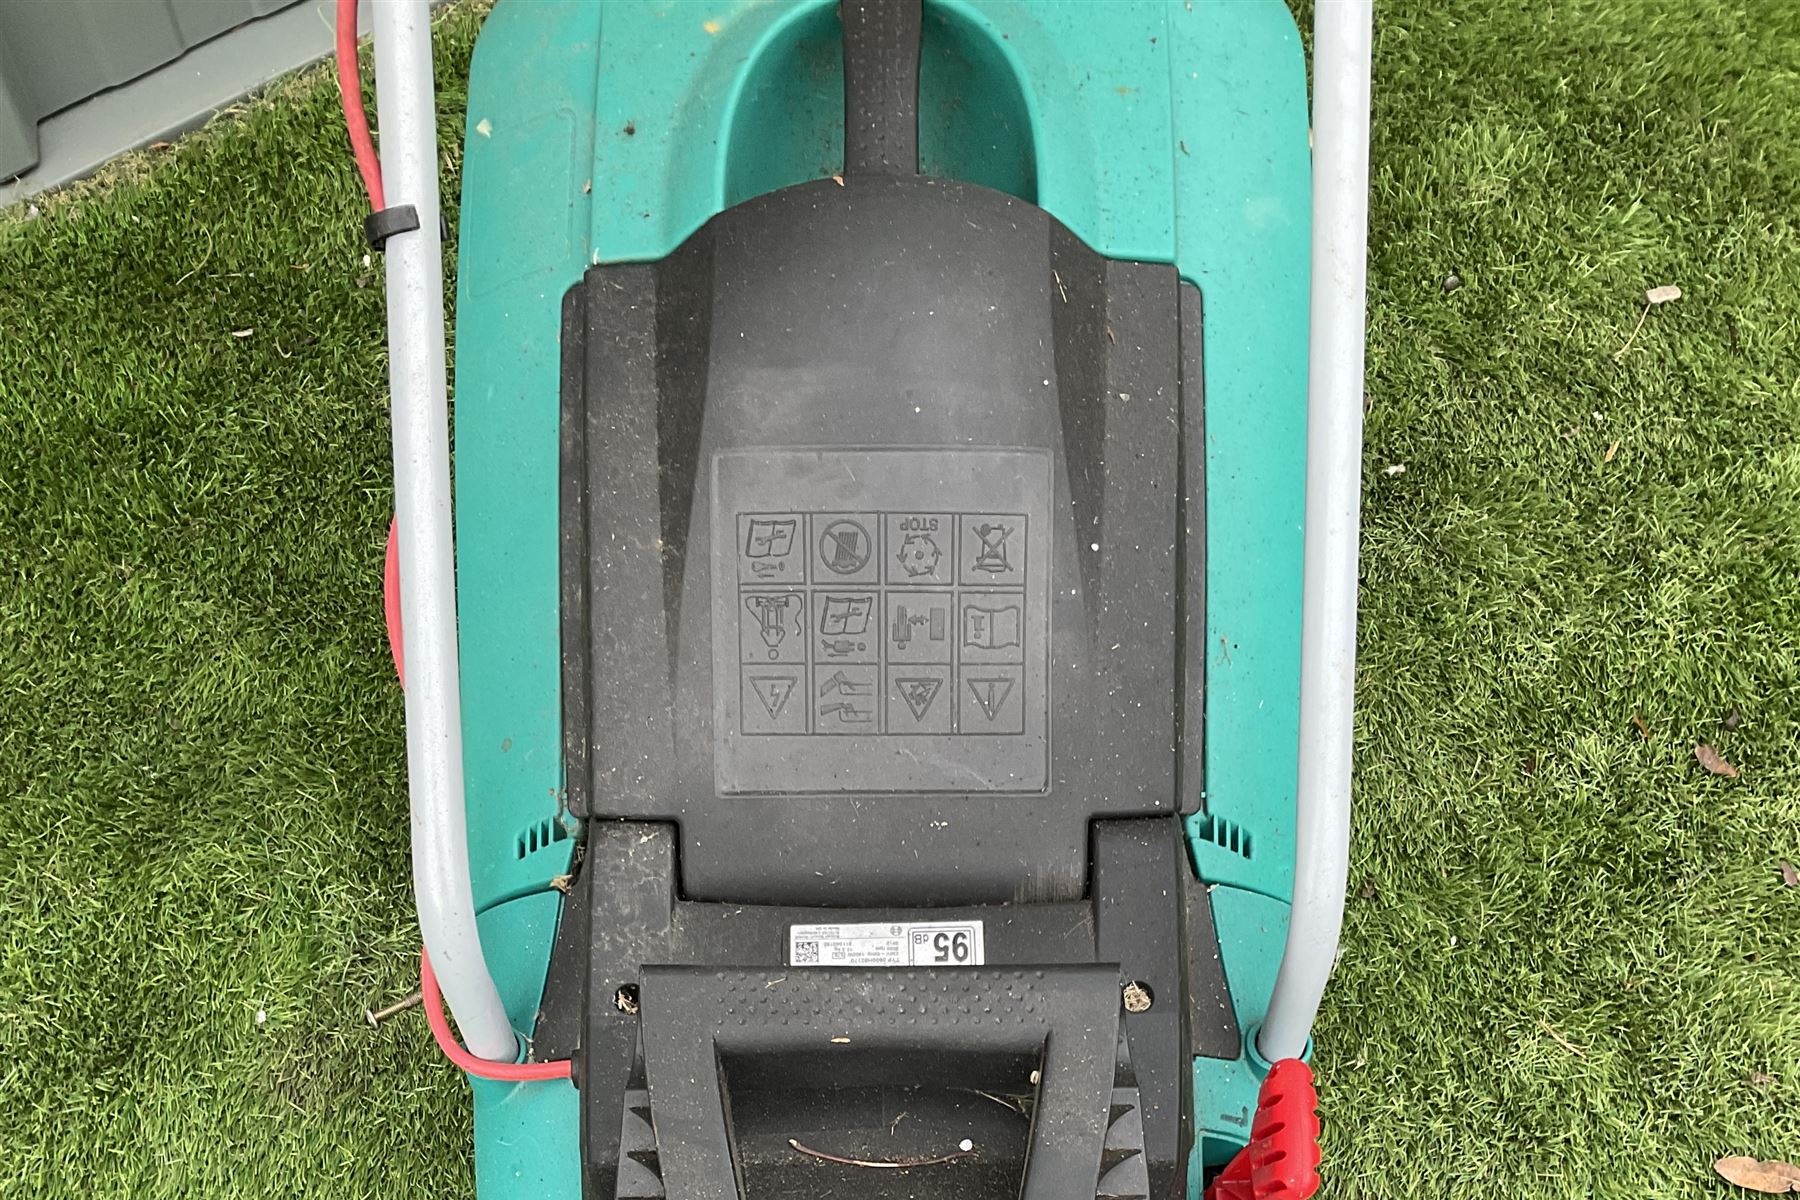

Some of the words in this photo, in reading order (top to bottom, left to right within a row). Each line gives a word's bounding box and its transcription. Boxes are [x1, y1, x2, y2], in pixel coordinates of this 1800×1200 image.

[900, 518, 938, 531] STOP
[914, 934, 929, 944] dB
[933, 932, 968, 962] 95
[1220, 1106, 1248, 1128] L
